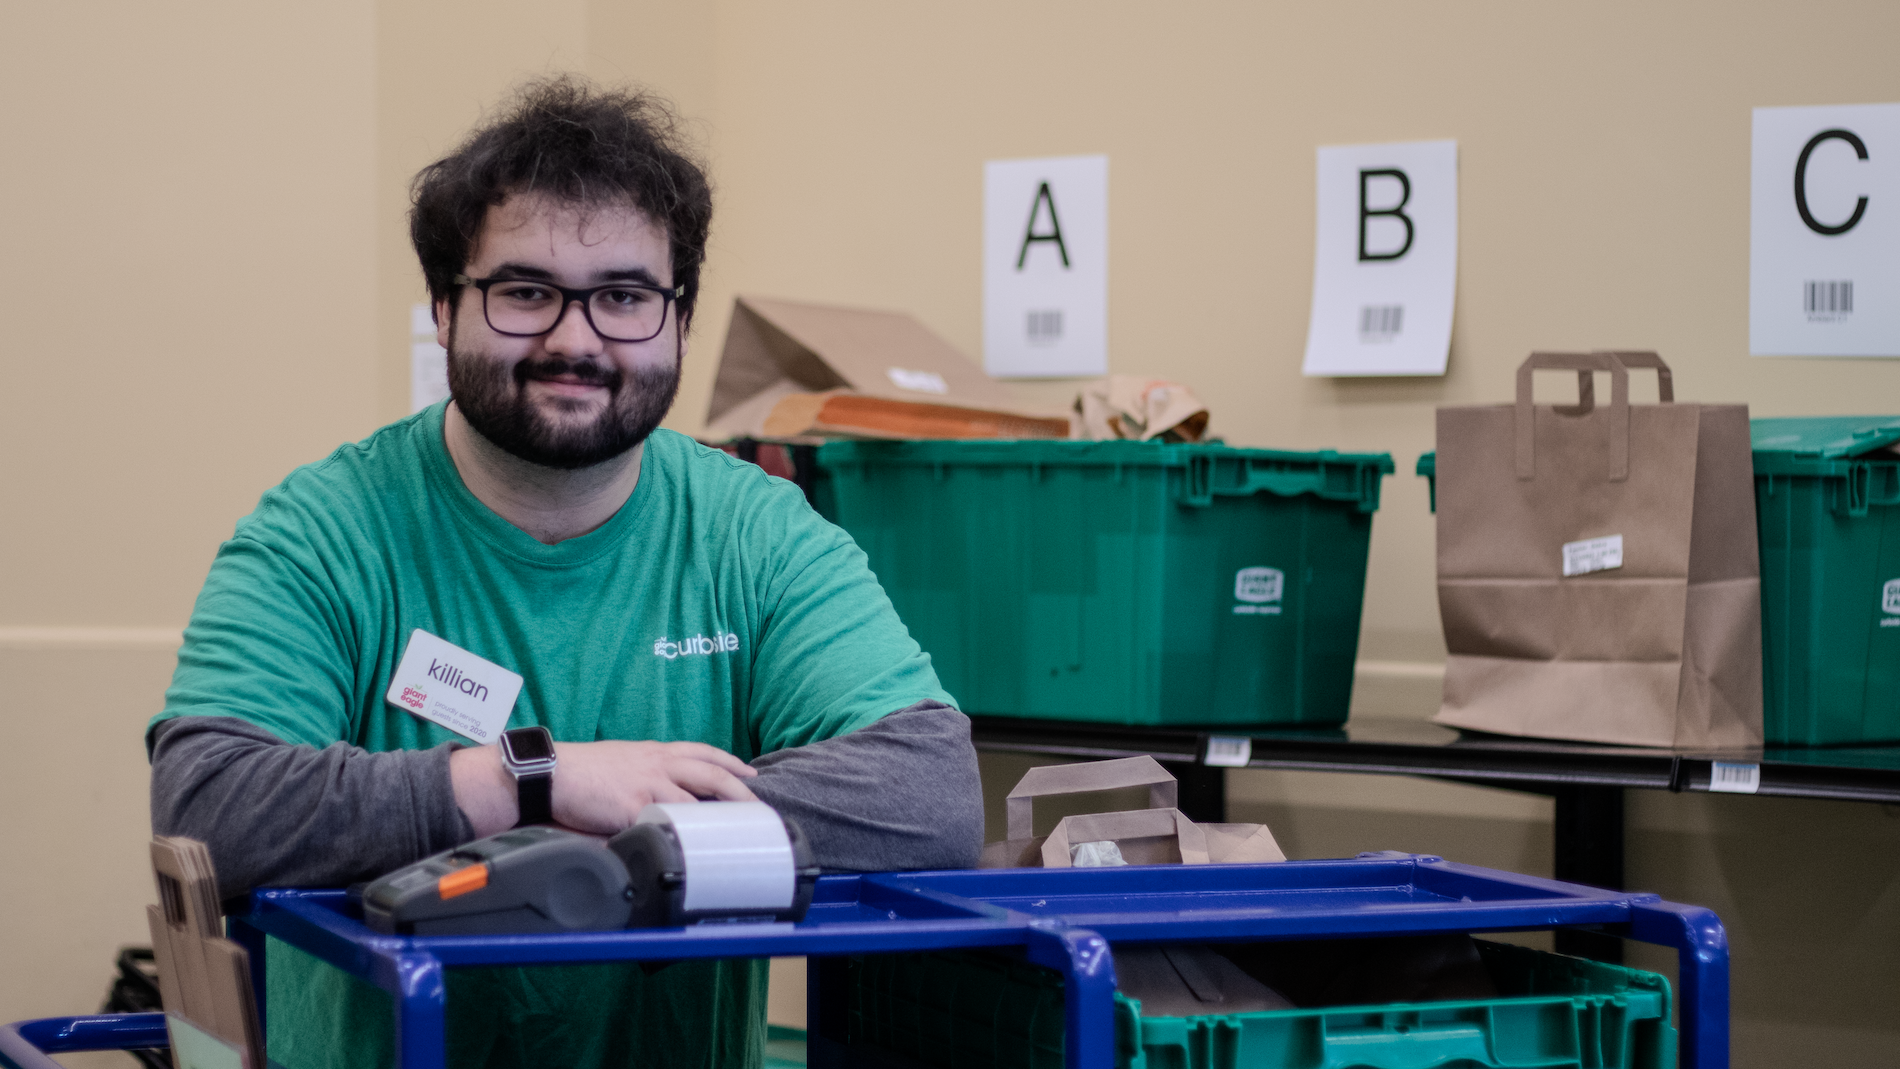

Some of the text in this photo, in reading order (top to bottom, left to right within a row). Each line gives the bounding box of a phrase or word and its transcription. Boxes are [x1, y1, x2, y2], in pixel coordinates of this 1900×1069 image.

[1794, 128, 1869, 237] C
[1016, 181, 1070, 269] A
[1358, 167, 1415, 262] B
[402, 687, 427, 701] giant
[427, 658, 488, 702] killian
[400, 694, 424, 709] eagle
[434, 700, 481, 727] proudly serving
[431, 708, 487, 738] guests since 2020
